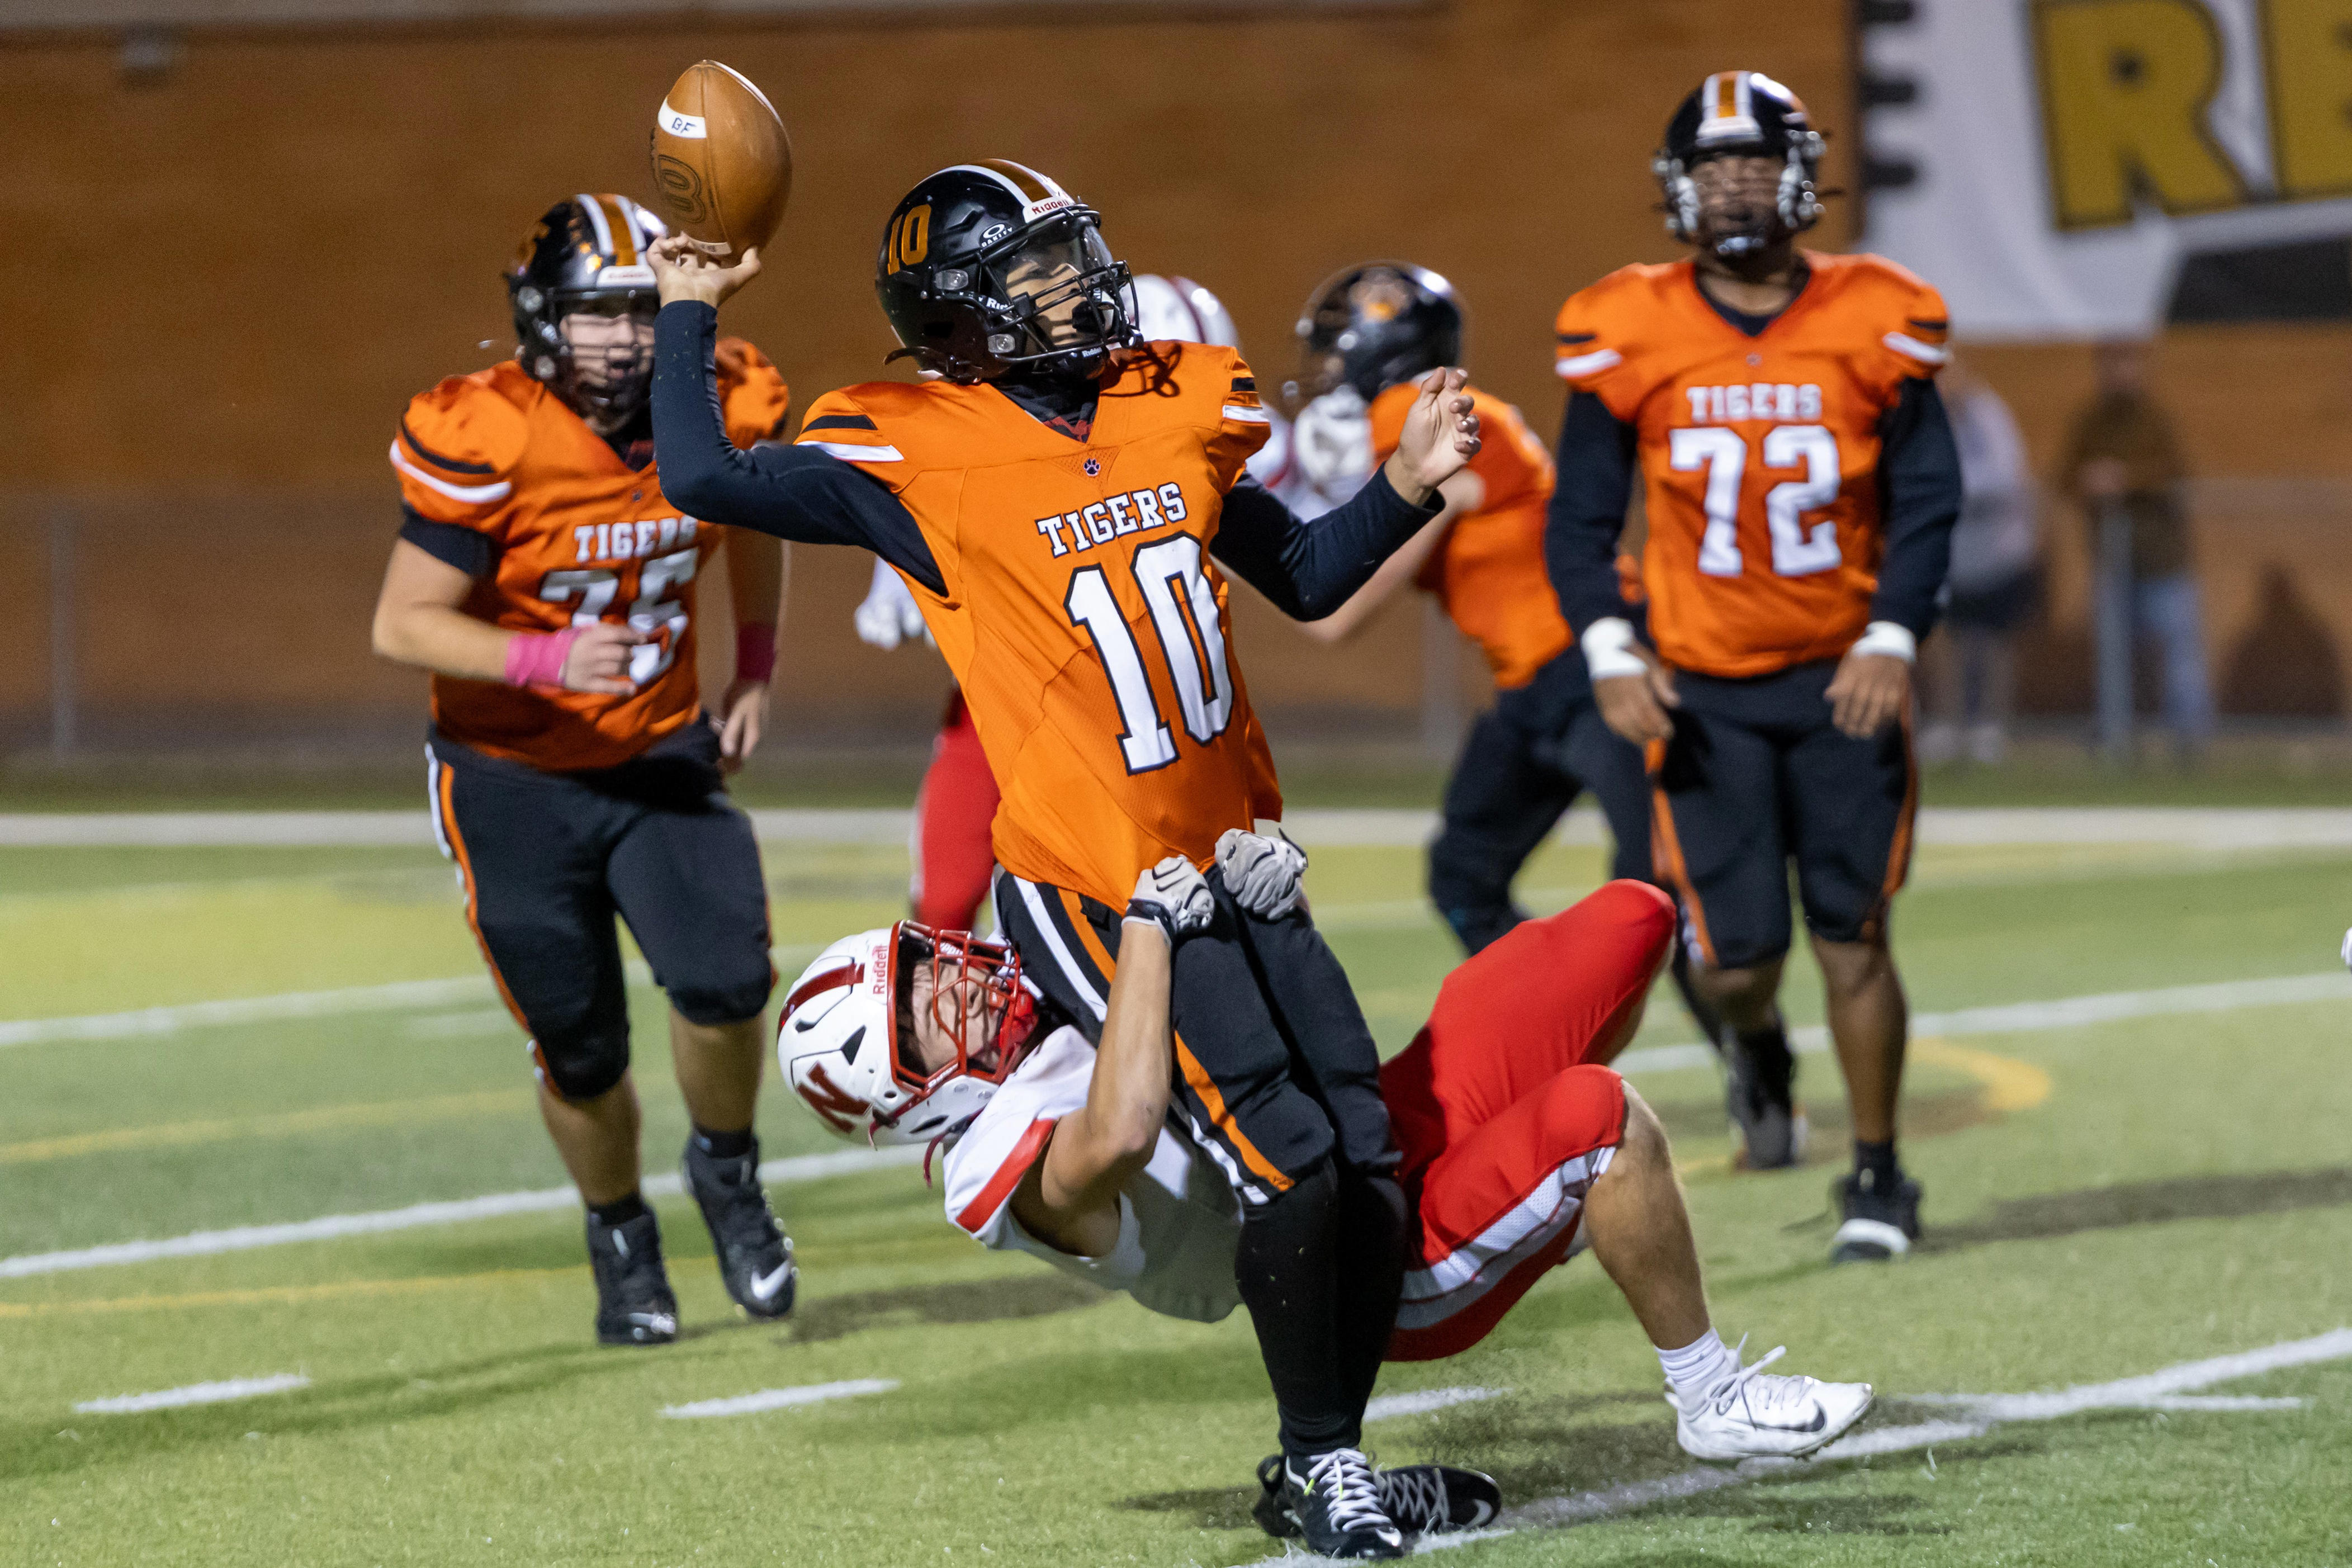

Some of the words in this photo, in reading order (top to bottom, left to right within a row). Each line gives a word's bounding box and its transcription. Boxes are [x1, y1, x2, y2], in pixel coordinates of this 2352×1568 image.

[671, 116, 697, 134] BF
[1031, 199, 1069, 215] Riddell
[888, 204, 932, 276] 10
[981, 227, 1012, 248] OAKLEY
[1686, 382, 1823, 423] TIGERS
[1034, 481, 1188, 559] TIGERS
[1668, 425, 1843, 578] 72
[1063, 530, 1234, 776] 10
[873, 944, 888, 994] Riddell
